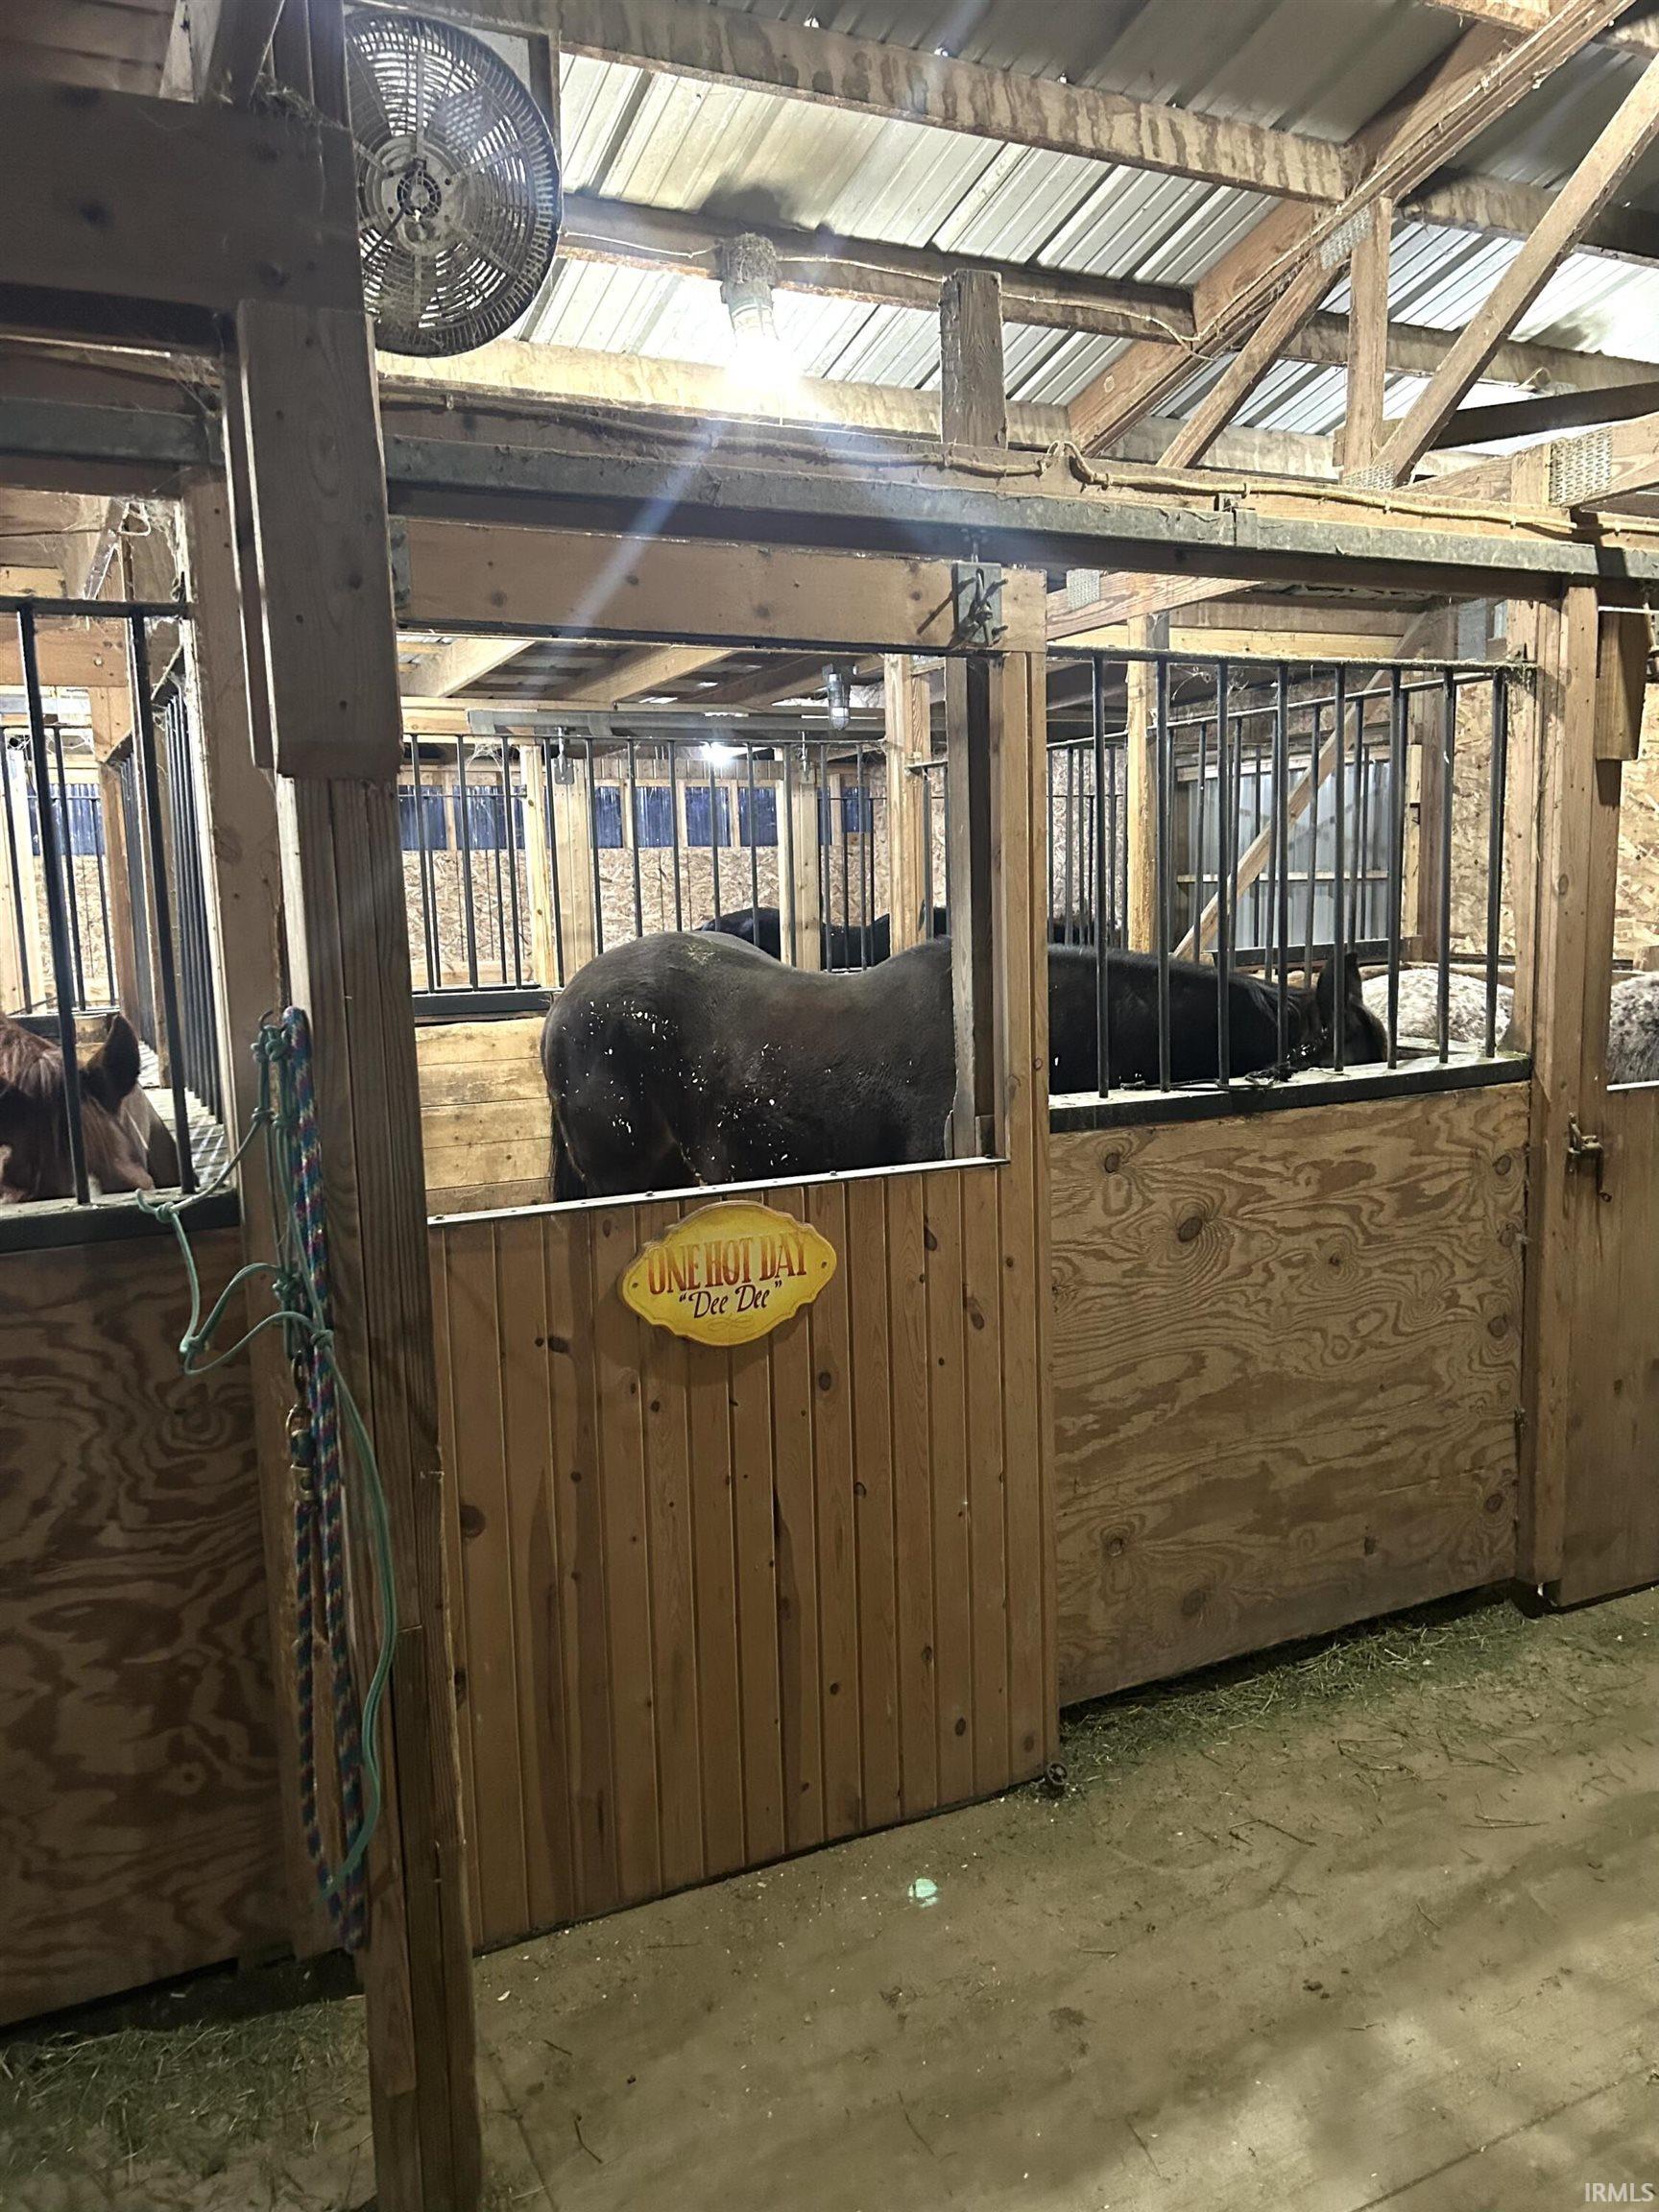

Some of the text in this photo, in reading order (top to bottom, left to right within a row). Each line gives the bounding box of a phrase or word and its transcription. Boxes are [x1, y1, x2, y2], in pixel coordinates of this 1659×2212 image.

[647, 1231, 806, 1295] ONE HOT DAY
